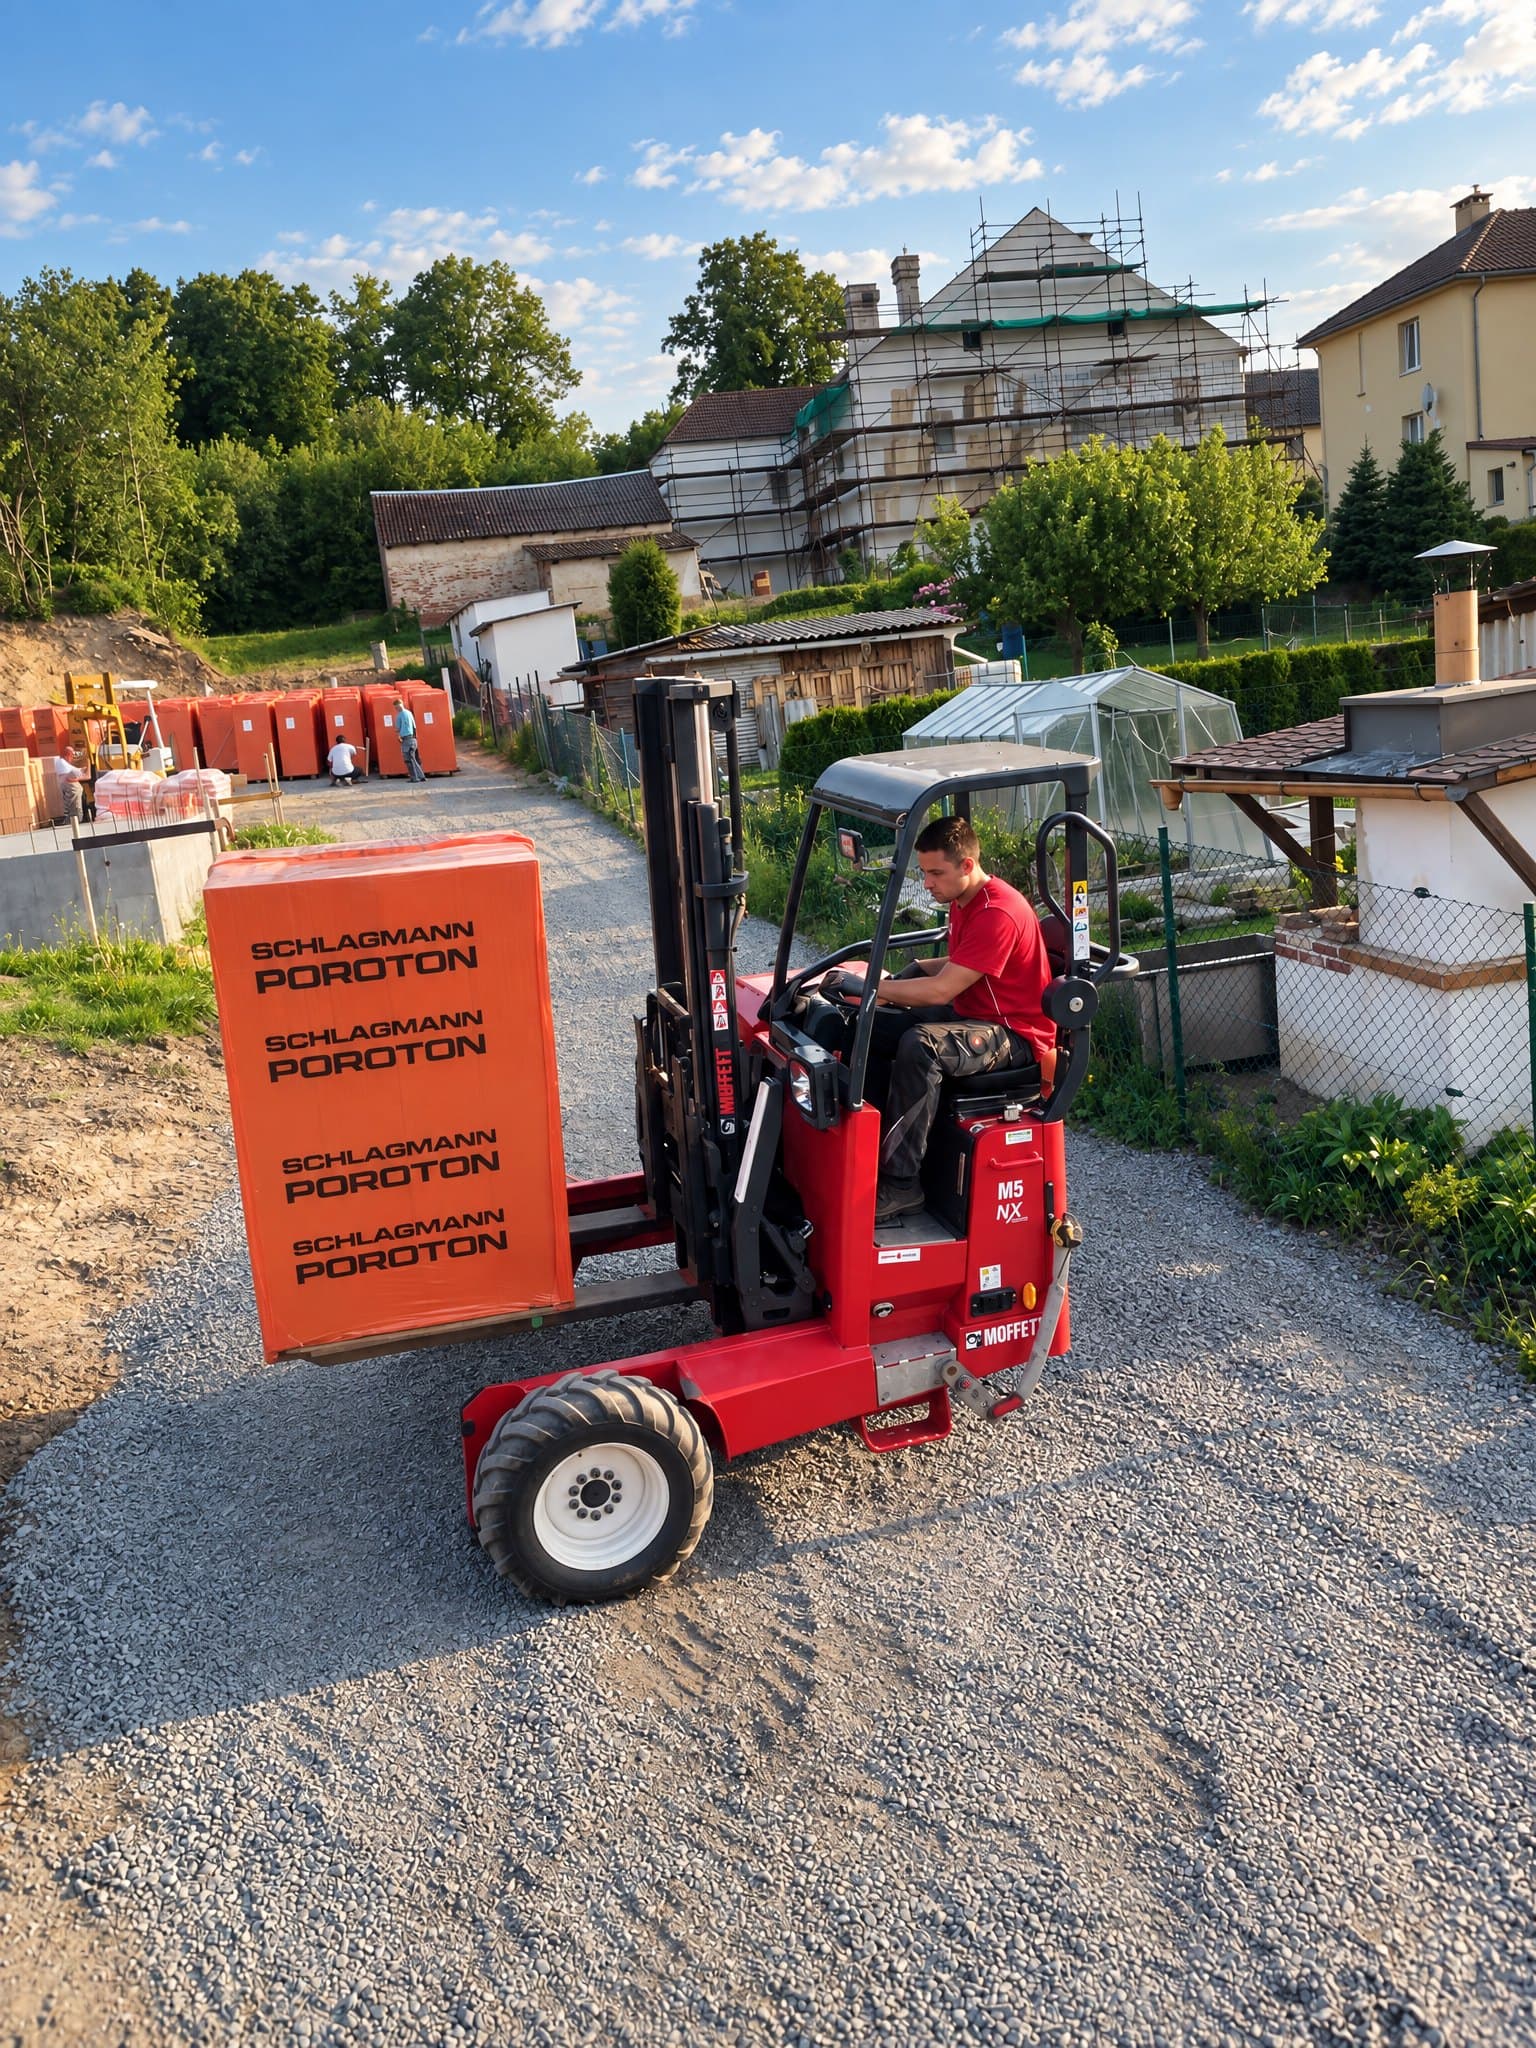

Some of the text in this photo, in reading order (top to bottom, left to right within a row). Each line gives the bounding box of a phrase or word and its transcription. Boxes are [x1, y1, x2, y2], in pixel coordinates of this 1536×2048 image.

[251, 921, 474, 960] SCHLAGMANN
[255, 946, 478, 994] POROTON
[265, 1010, 483, 1052] SCHLAGMANN
[268, 1034, 486, 1083] POROTON
[282, 1129, 497, 1175] SCHLAGMANN
[285, 1151, 500, 1204] POROTON
[998, 1179, 1024, 1201] M5
[293, 1208, 505, 1257] SCHLAGMANN
[996, 1201, 1024, 1224] NX
[296, 1231, 508, 1285] POROTON
[983, 1317, 1042, 1347] MOFFET
